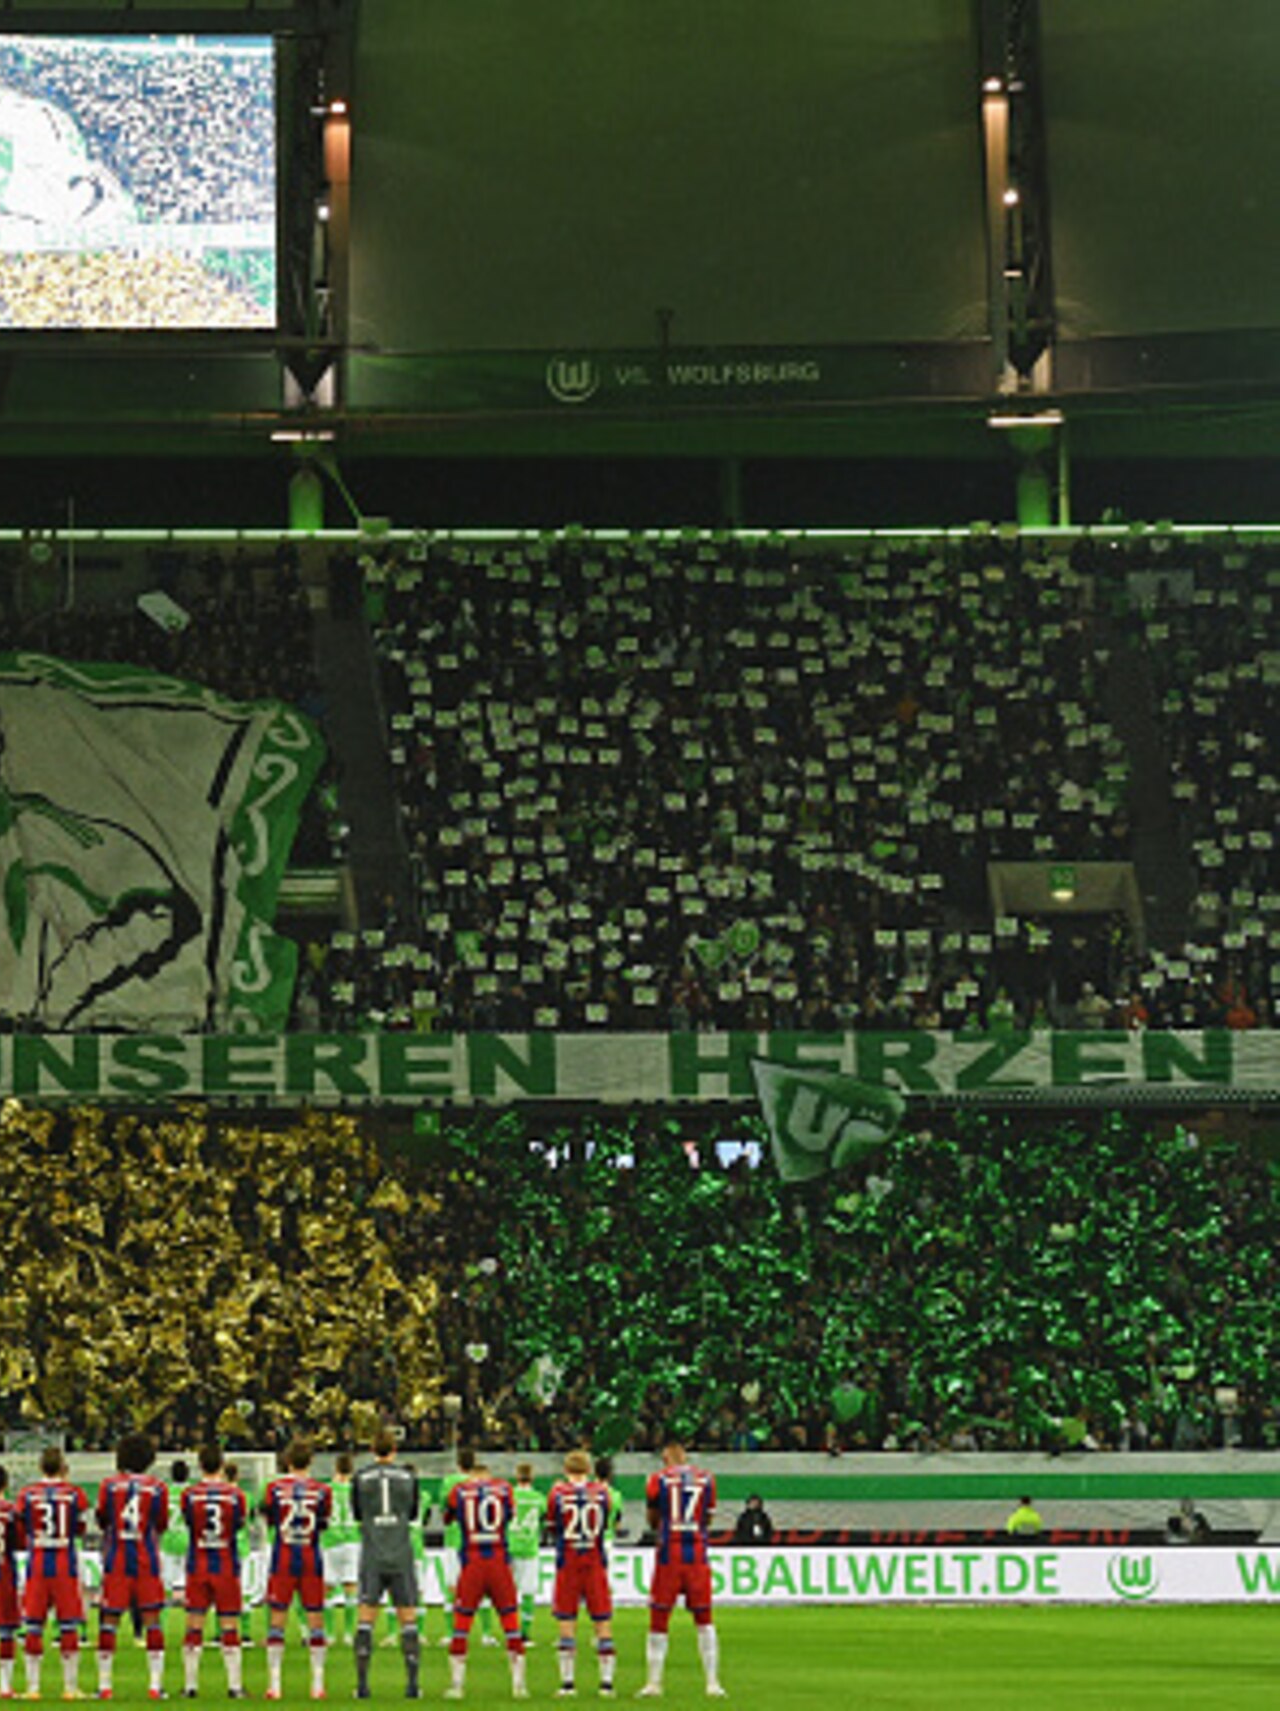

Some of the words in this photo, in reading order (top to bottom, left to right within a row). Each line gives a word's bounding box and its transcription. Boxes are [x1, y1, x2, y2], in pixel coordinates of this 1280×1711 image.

[667, 361, 820, 385] WOLFSBURG
[669, 1028, 1232, 1095] HERZEN
[120, 1493, 140, 1531] 4
[380, 1478, 391, 1515] 1
[465, 1497, 503, 1532] 10
[671, 1485, 703, 1521] 17
[34, 1502, 67, 1538] 31
[203, 1502, 222, 1536] 3
[280, 1500, 317, 1537] 25
[563, 1503, 604, 1540] 20
